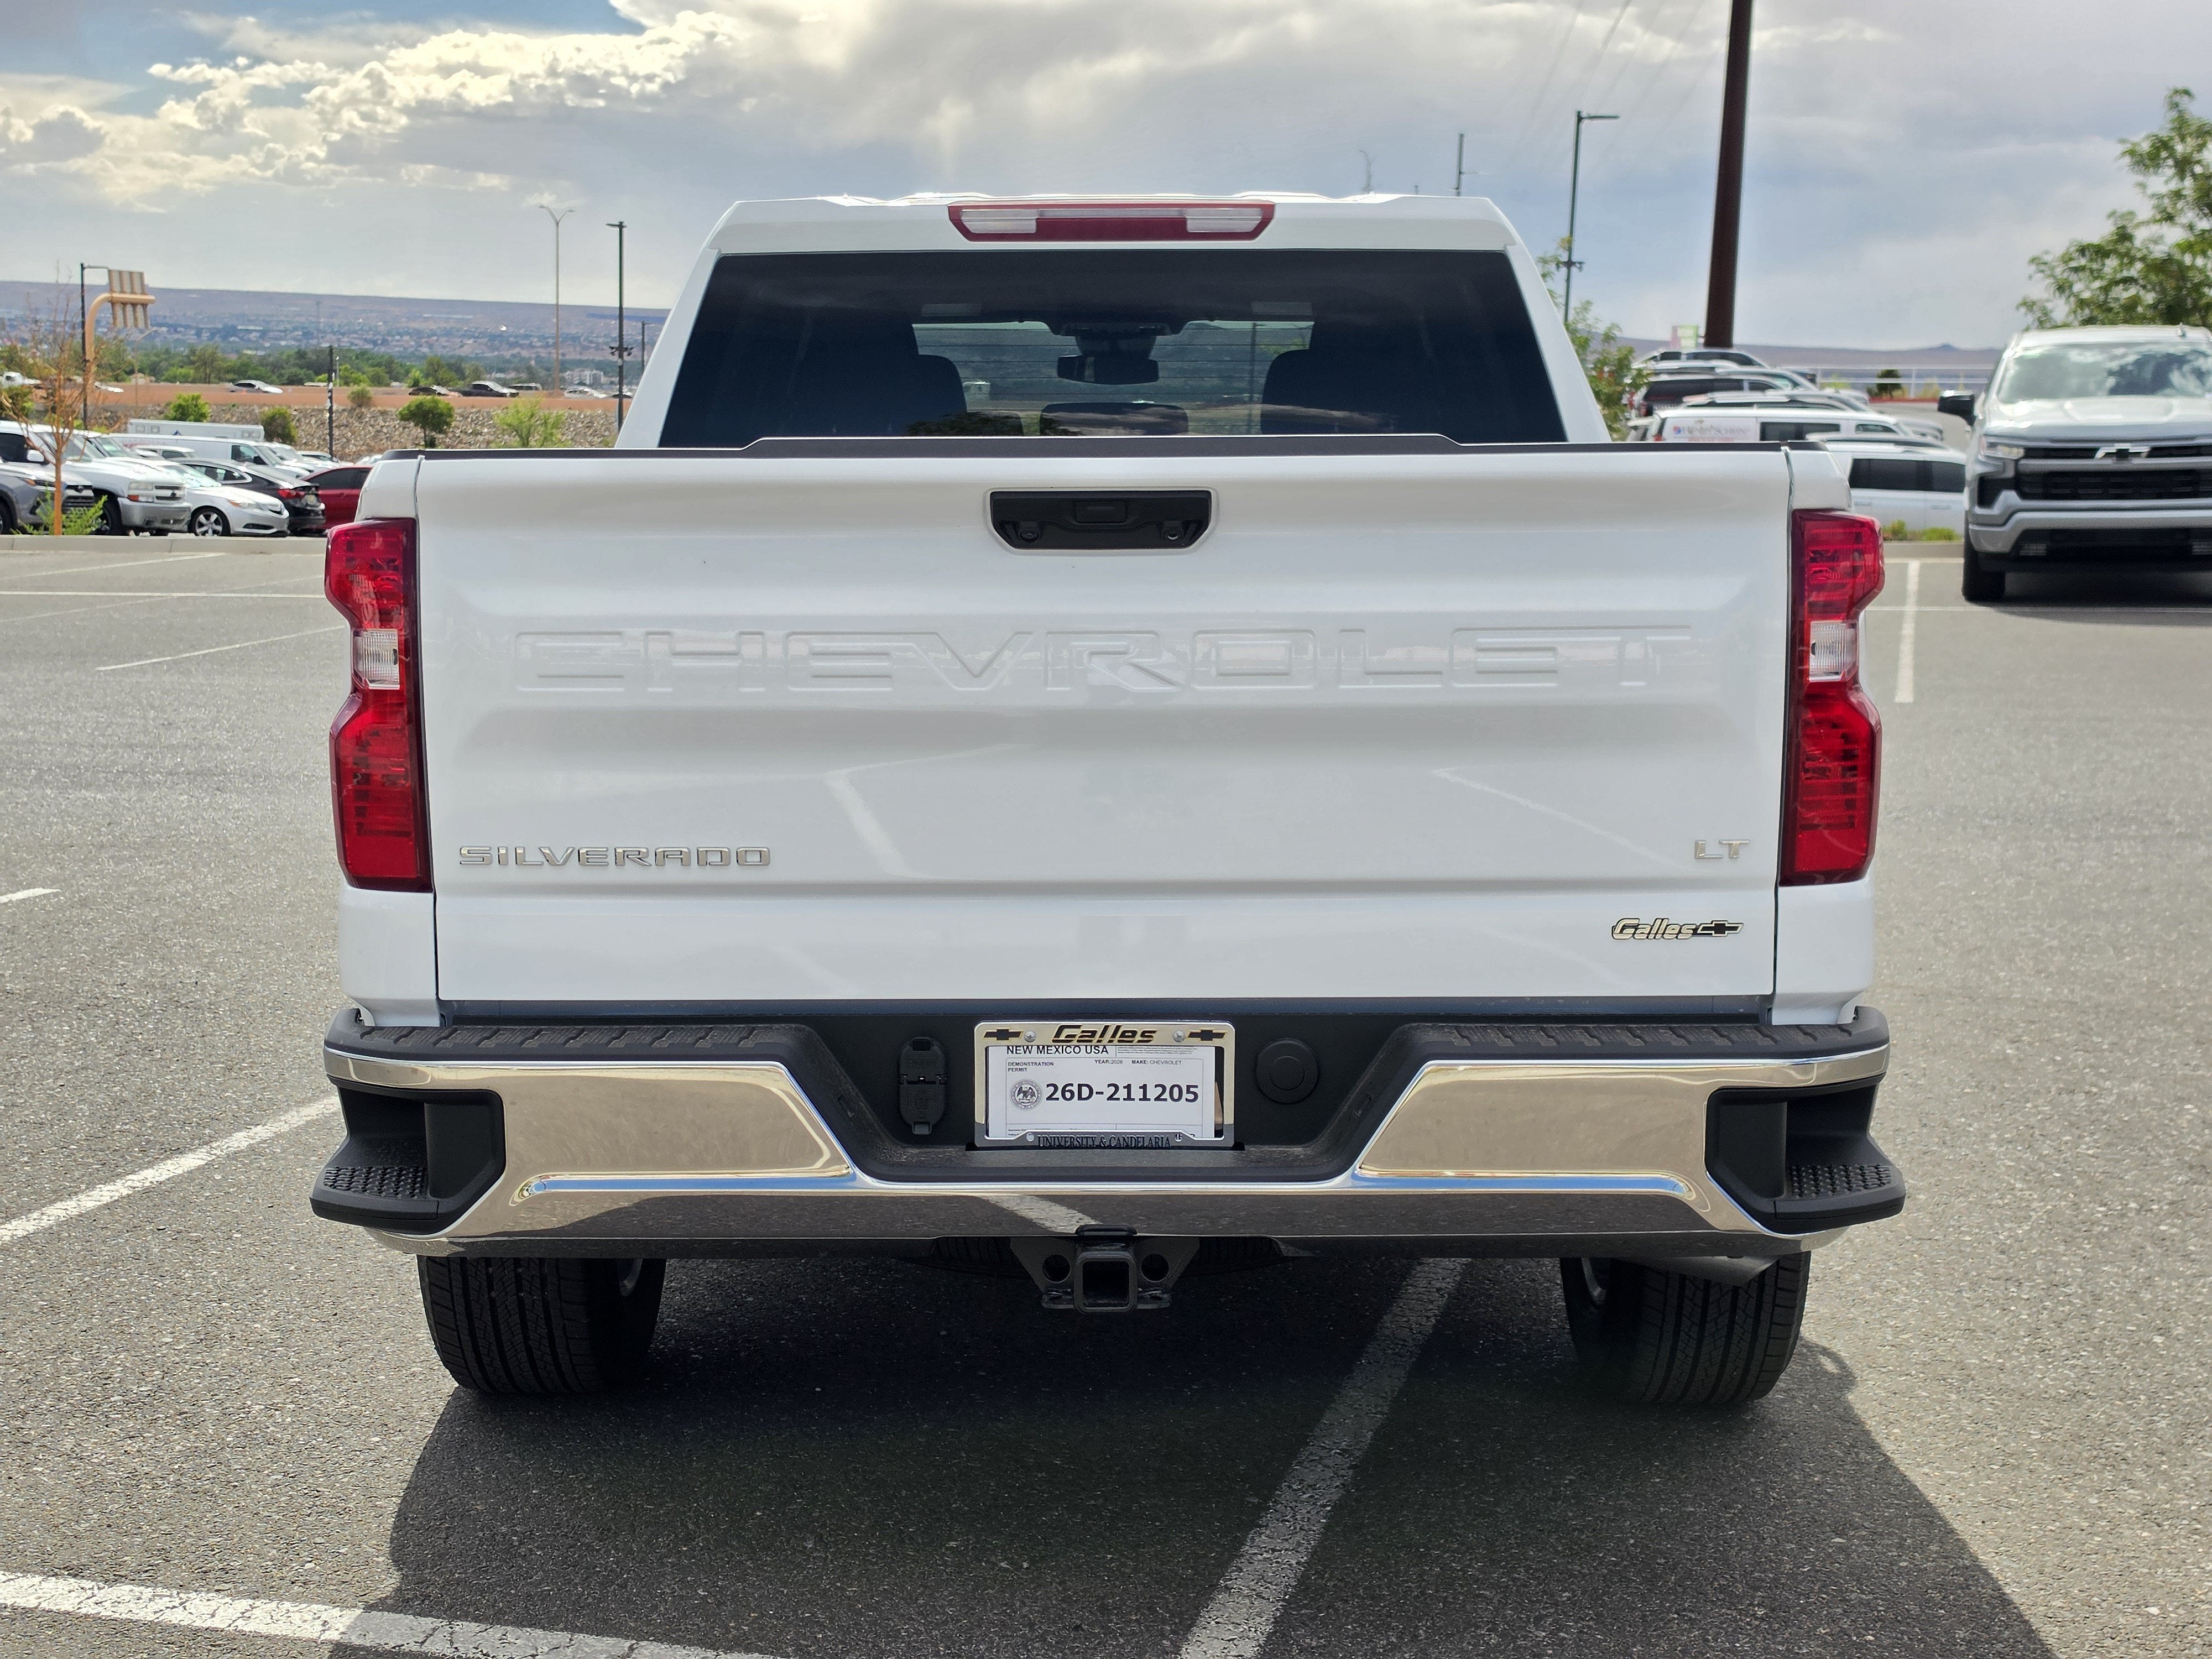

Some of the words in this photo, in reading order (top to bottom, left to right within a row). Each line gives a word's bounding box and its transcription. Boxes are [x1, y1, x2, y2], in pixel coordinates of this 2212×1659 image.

[515, 625, 1693, 692] CHEVROLET
[459, 846, 771, 867] SILVERADO
[1694, 839, 1750, 859] LT
[1611, 917, 1697, 940] Galles
[1052, 1024, 1158, 1044] Galles
[1006, 1046, 1032, 1055] NEW
[1036, 1046, 1081, 1055] MEXICO
[1085, 1046, 1109, 1055] USA
[1046, 1083, 1198, 1103] 26D-211205
[1037, 1135, 1097, 1147] UNIVERSITY
[1099, 1135, 1107, 1147] &
[1109, 1135, 1171, 1148] CANDELARIA
